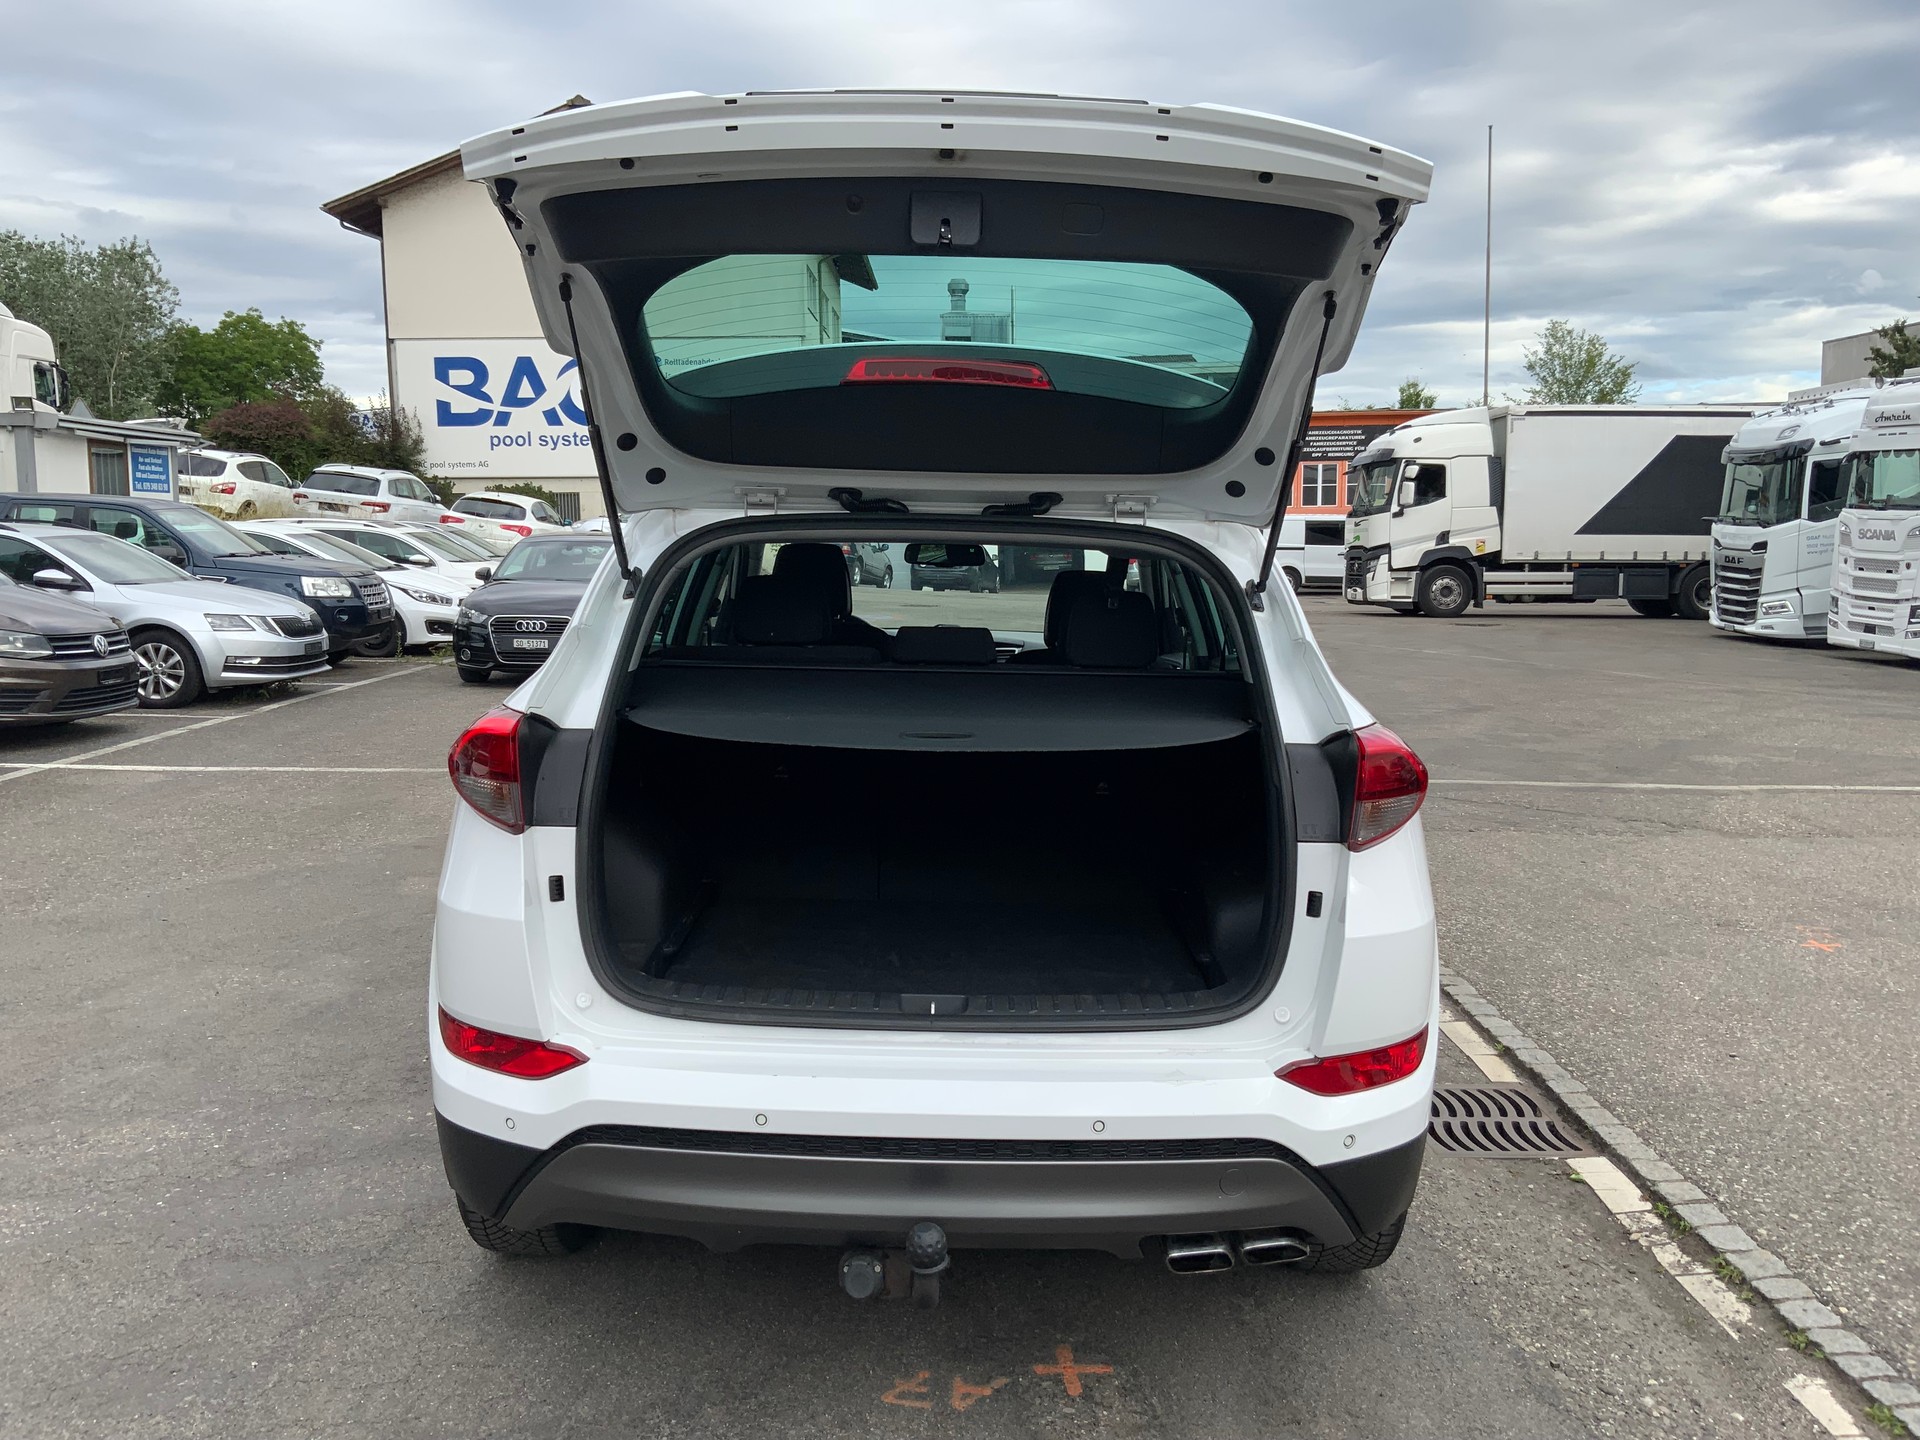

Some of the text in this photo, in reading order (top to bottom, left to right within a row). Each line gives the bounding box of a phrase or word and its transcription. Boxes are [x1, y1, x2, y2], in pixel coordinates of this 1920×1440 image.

[490, 431, 590, 451] pool syste
[429, 460, 446, 470] pool
[447, 461, 477, 470] systems
[478, 460, 489, 468] AG
[1857, 528, 1897, 542] SCANIA
[1724, 555, 1744, 565] DAF
